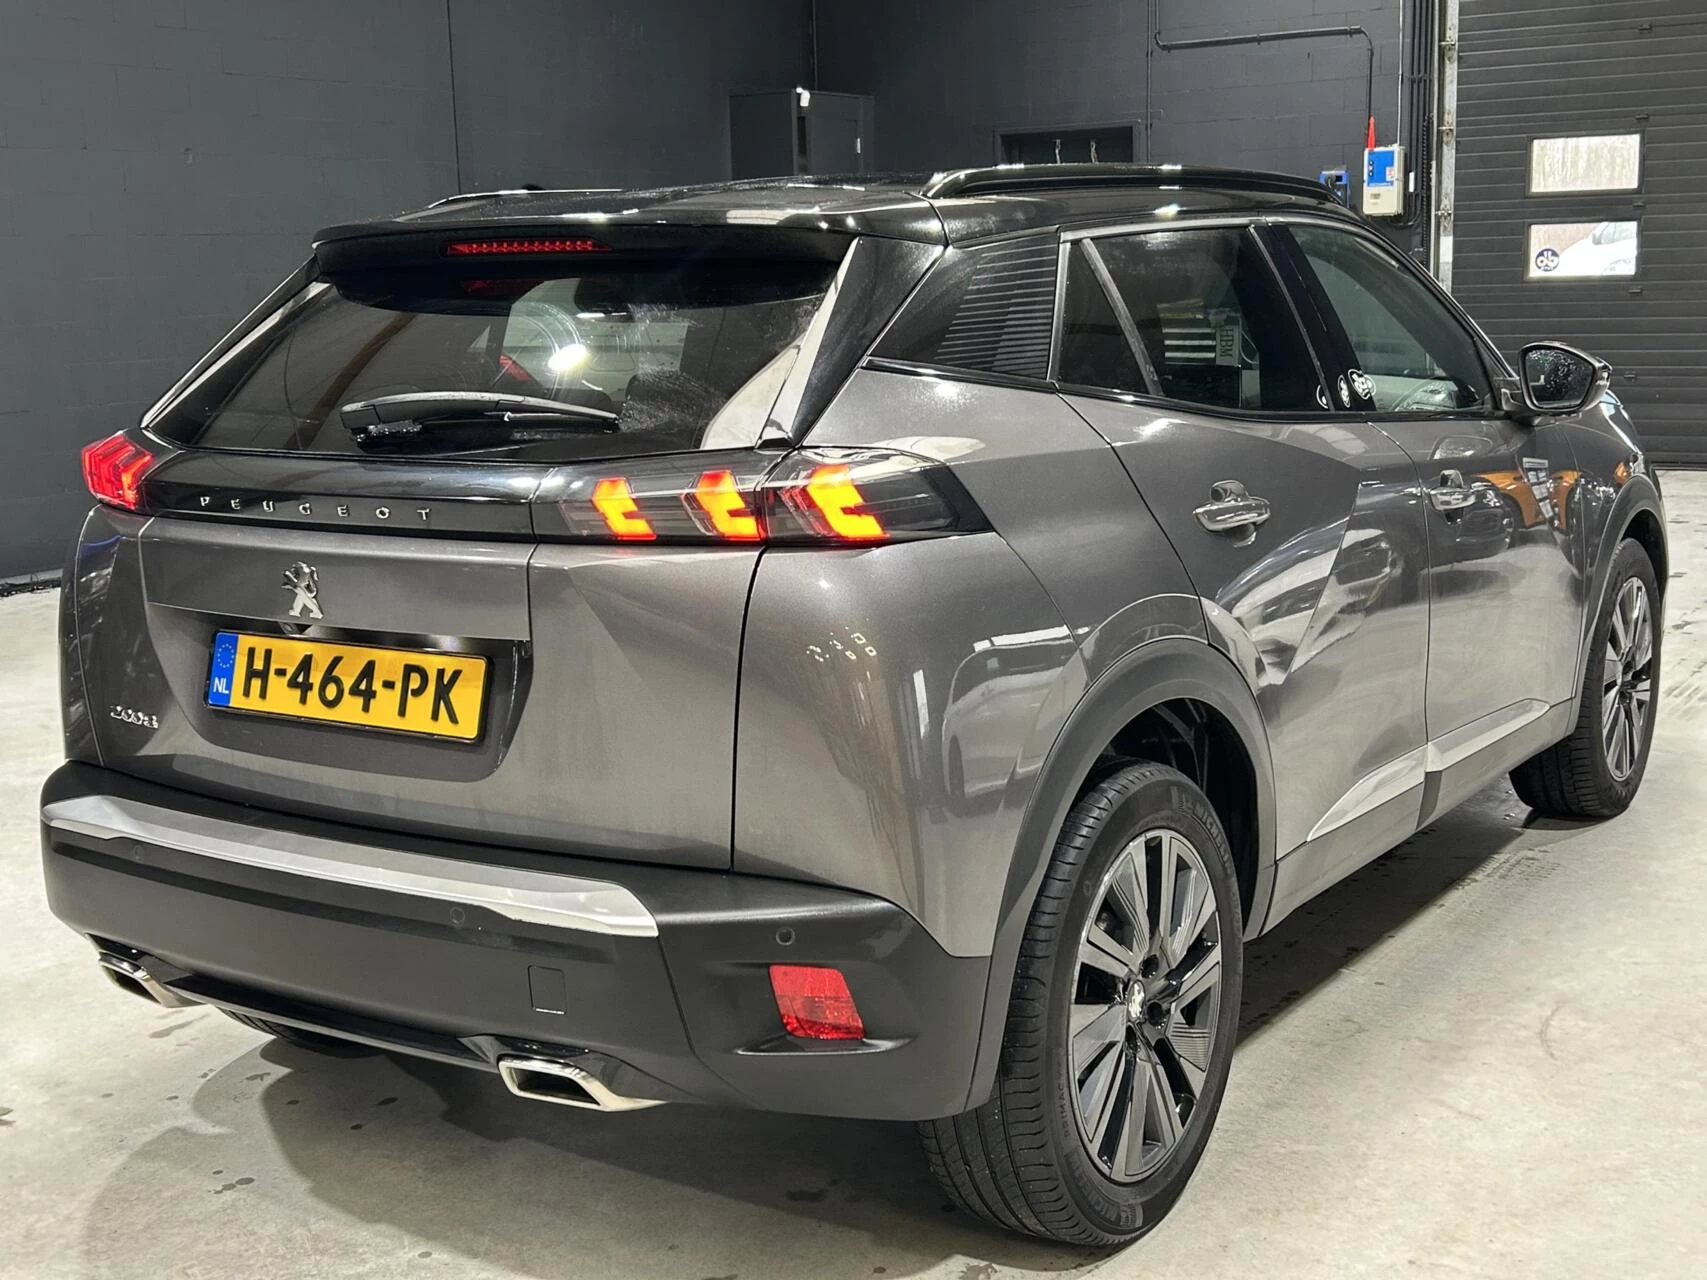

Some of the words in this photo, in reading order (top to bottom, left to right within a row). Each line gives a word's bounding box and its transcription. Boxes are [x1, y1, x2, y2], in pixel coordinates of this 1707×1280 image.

[200, 496, 430, 521] PEUGEOT
[213, 678, 229, 694] NL
[242, 646, 463, 725] H-464-PK
